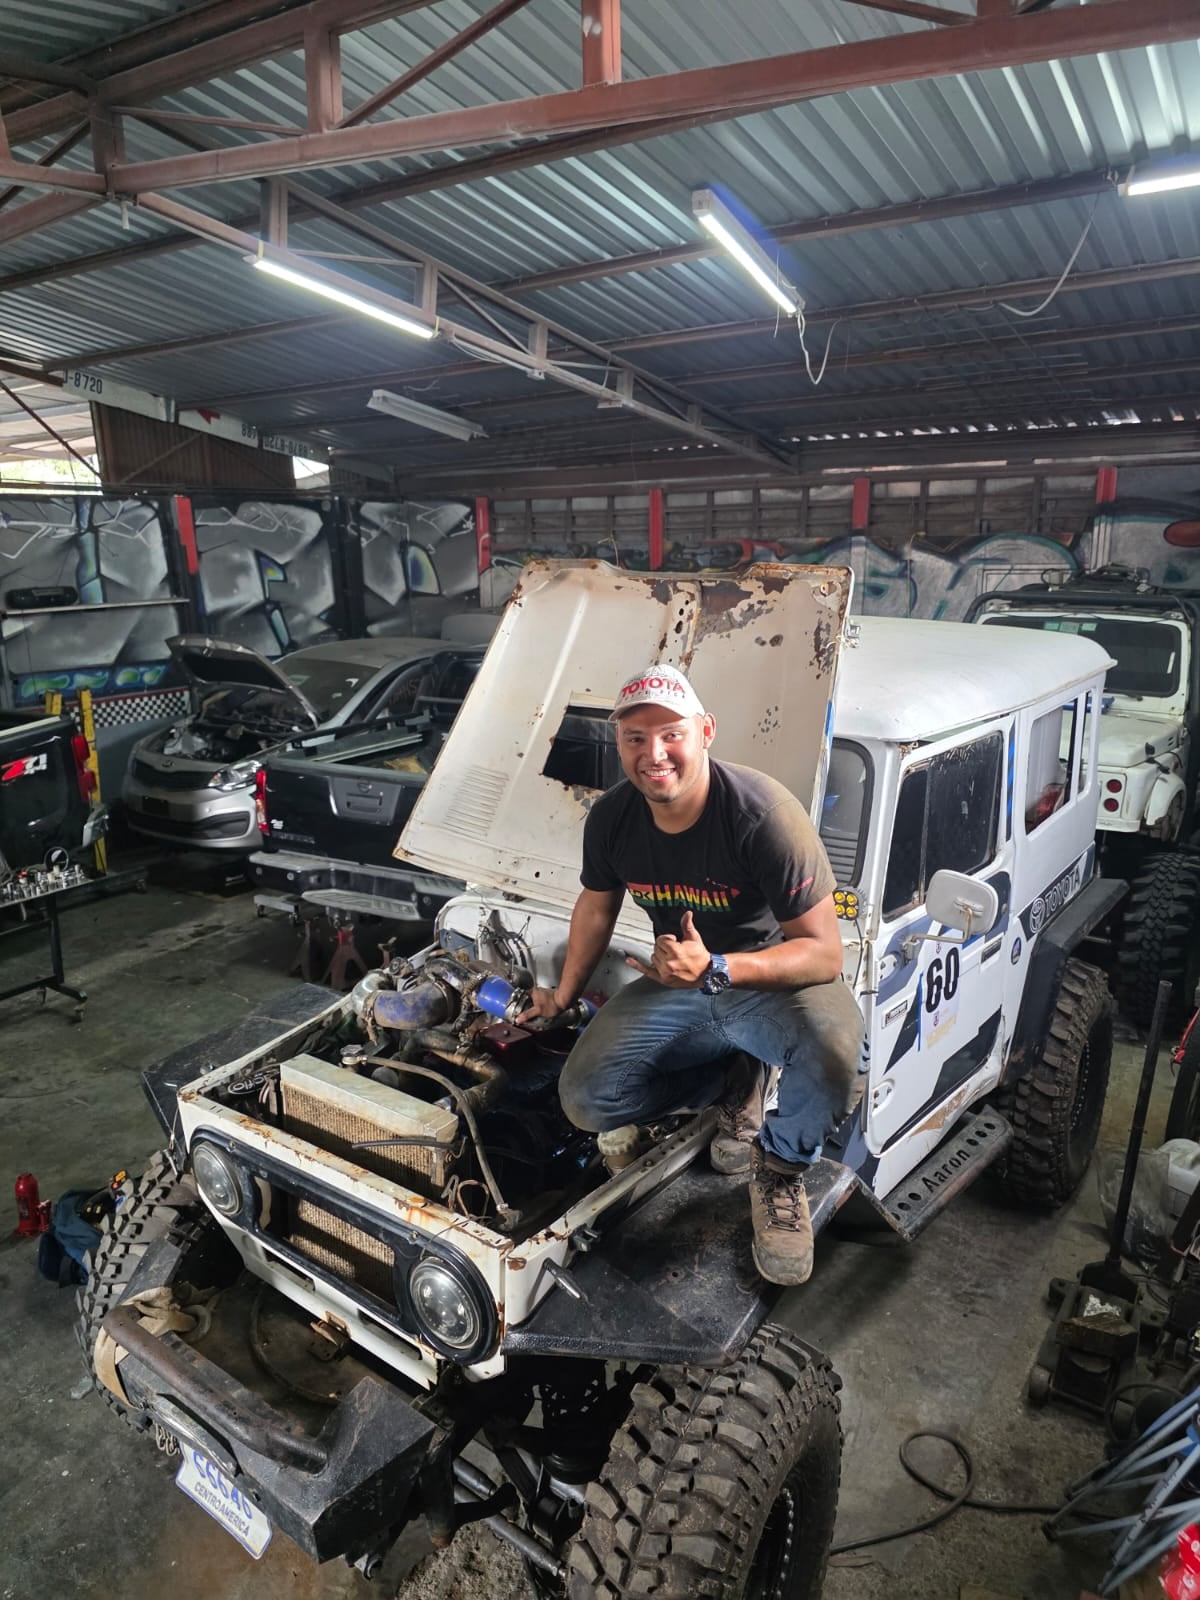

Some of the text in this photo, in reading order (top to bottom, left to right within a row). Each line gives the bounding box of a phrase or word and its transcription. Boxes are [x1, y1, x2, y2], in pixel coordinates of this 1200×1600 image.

[621, 677, 686, 698] TOYOTA
[655, 884, 731, 913] HAWAII
[1045, 864, 1081, 918] TOYOTA
[925, 947, 960, 1014] 60
[921, 1149, 971, 1193] Aaron
[194, 1481, 251, 1538] CENTROAMERICA
